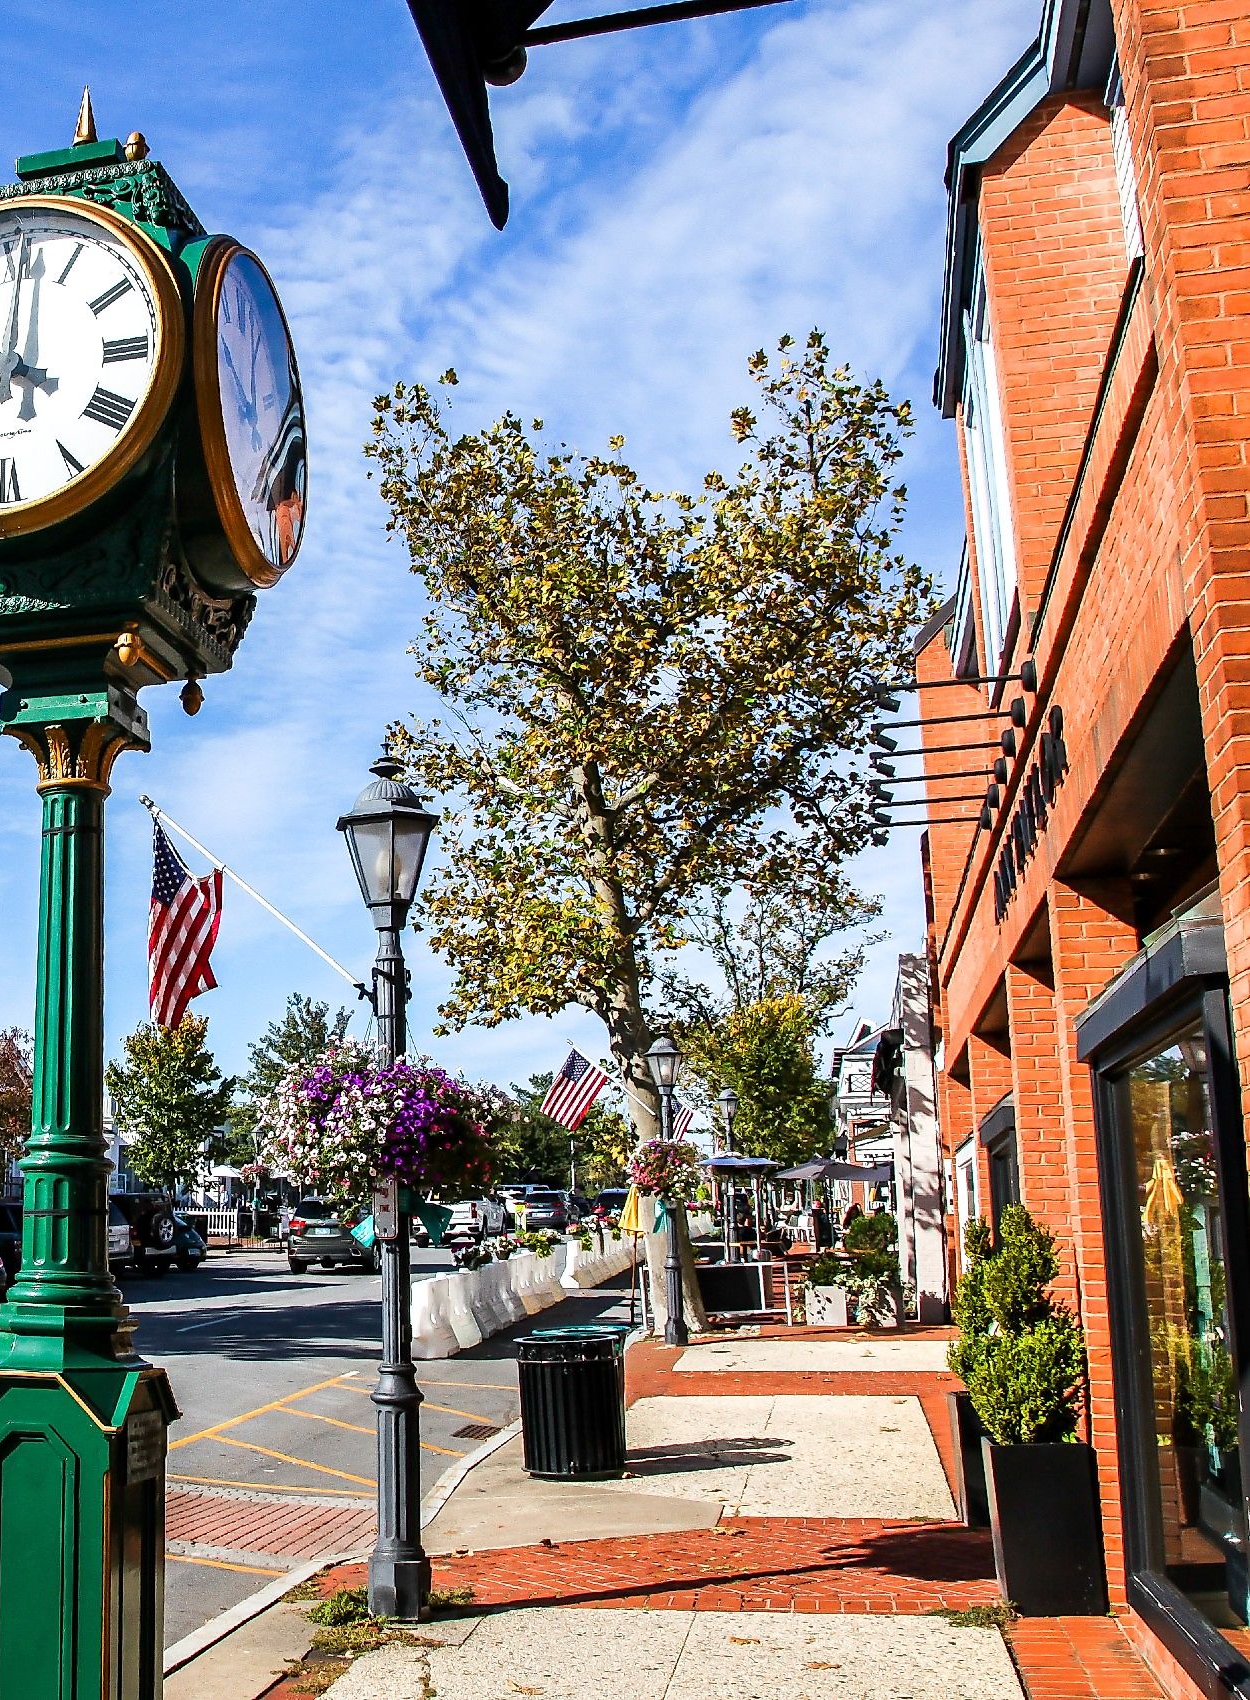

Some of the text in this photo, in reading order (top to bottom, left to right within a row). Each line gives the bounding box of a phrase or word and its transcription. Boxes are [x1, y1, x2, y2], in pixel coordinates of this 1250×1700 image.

[86, 273, 136, 320] II
[101, 328, 149, 369] III
[78, 381, 139, 439] IIII
[55, 438, 91, 483] V
